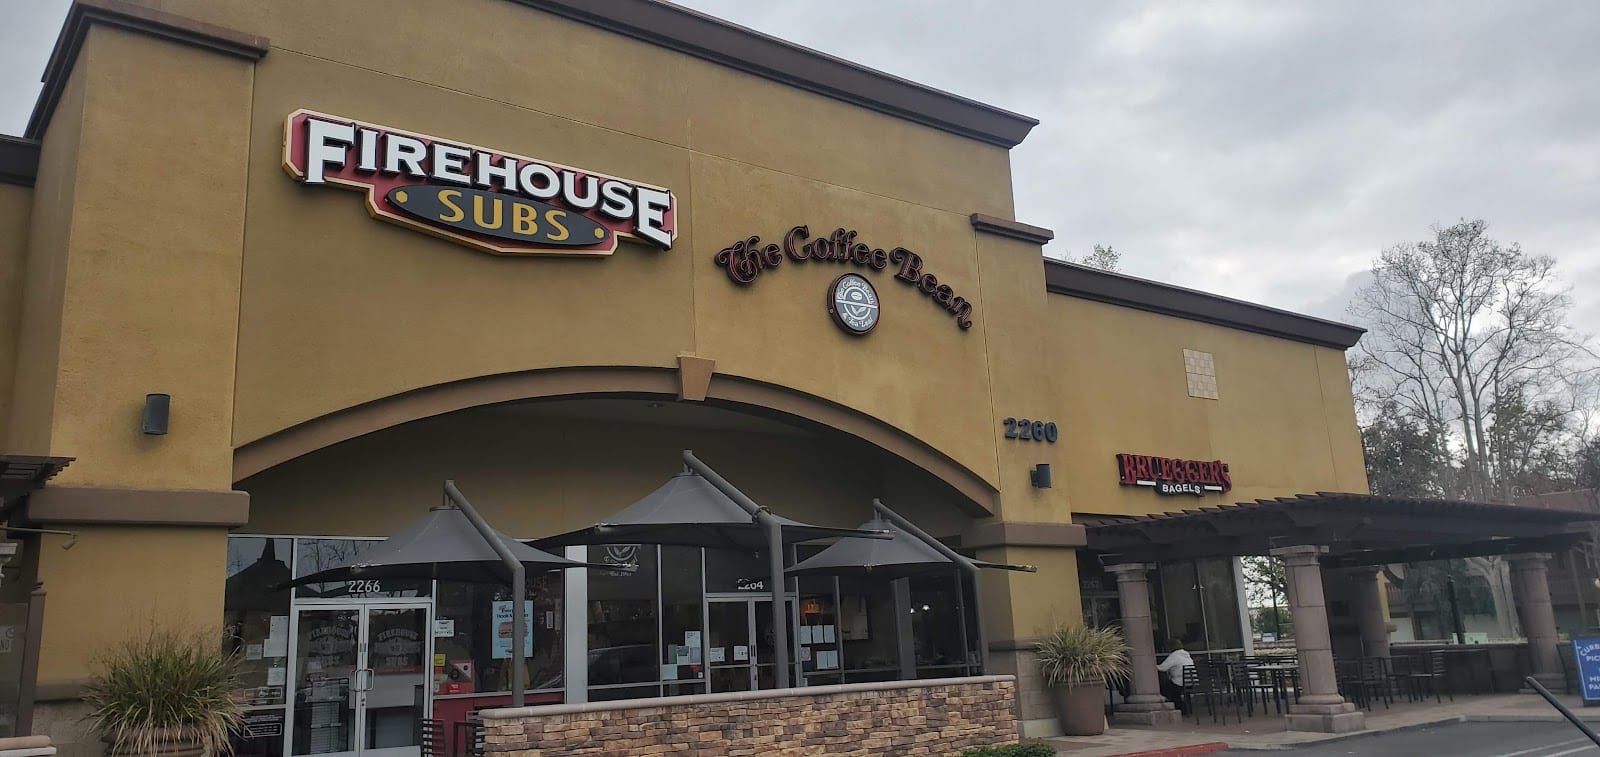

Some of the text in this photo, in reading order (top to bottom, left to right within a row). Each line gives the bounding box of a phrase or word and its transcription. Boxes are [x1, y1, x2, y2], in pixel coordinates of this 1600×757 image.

[304, 118, 672, 251] FIREHOUSE
[438, 189, 569, 241] SUBS
[714, 224, 973, 331] The Coffee Bean
[1003, 417, 1058, 443] 2260
[1117, 453, 1232, 493] BRUEGGER'S
[1162, 483, 1201, 494] BAGELS
[348, 580, 381, 593] 2266
